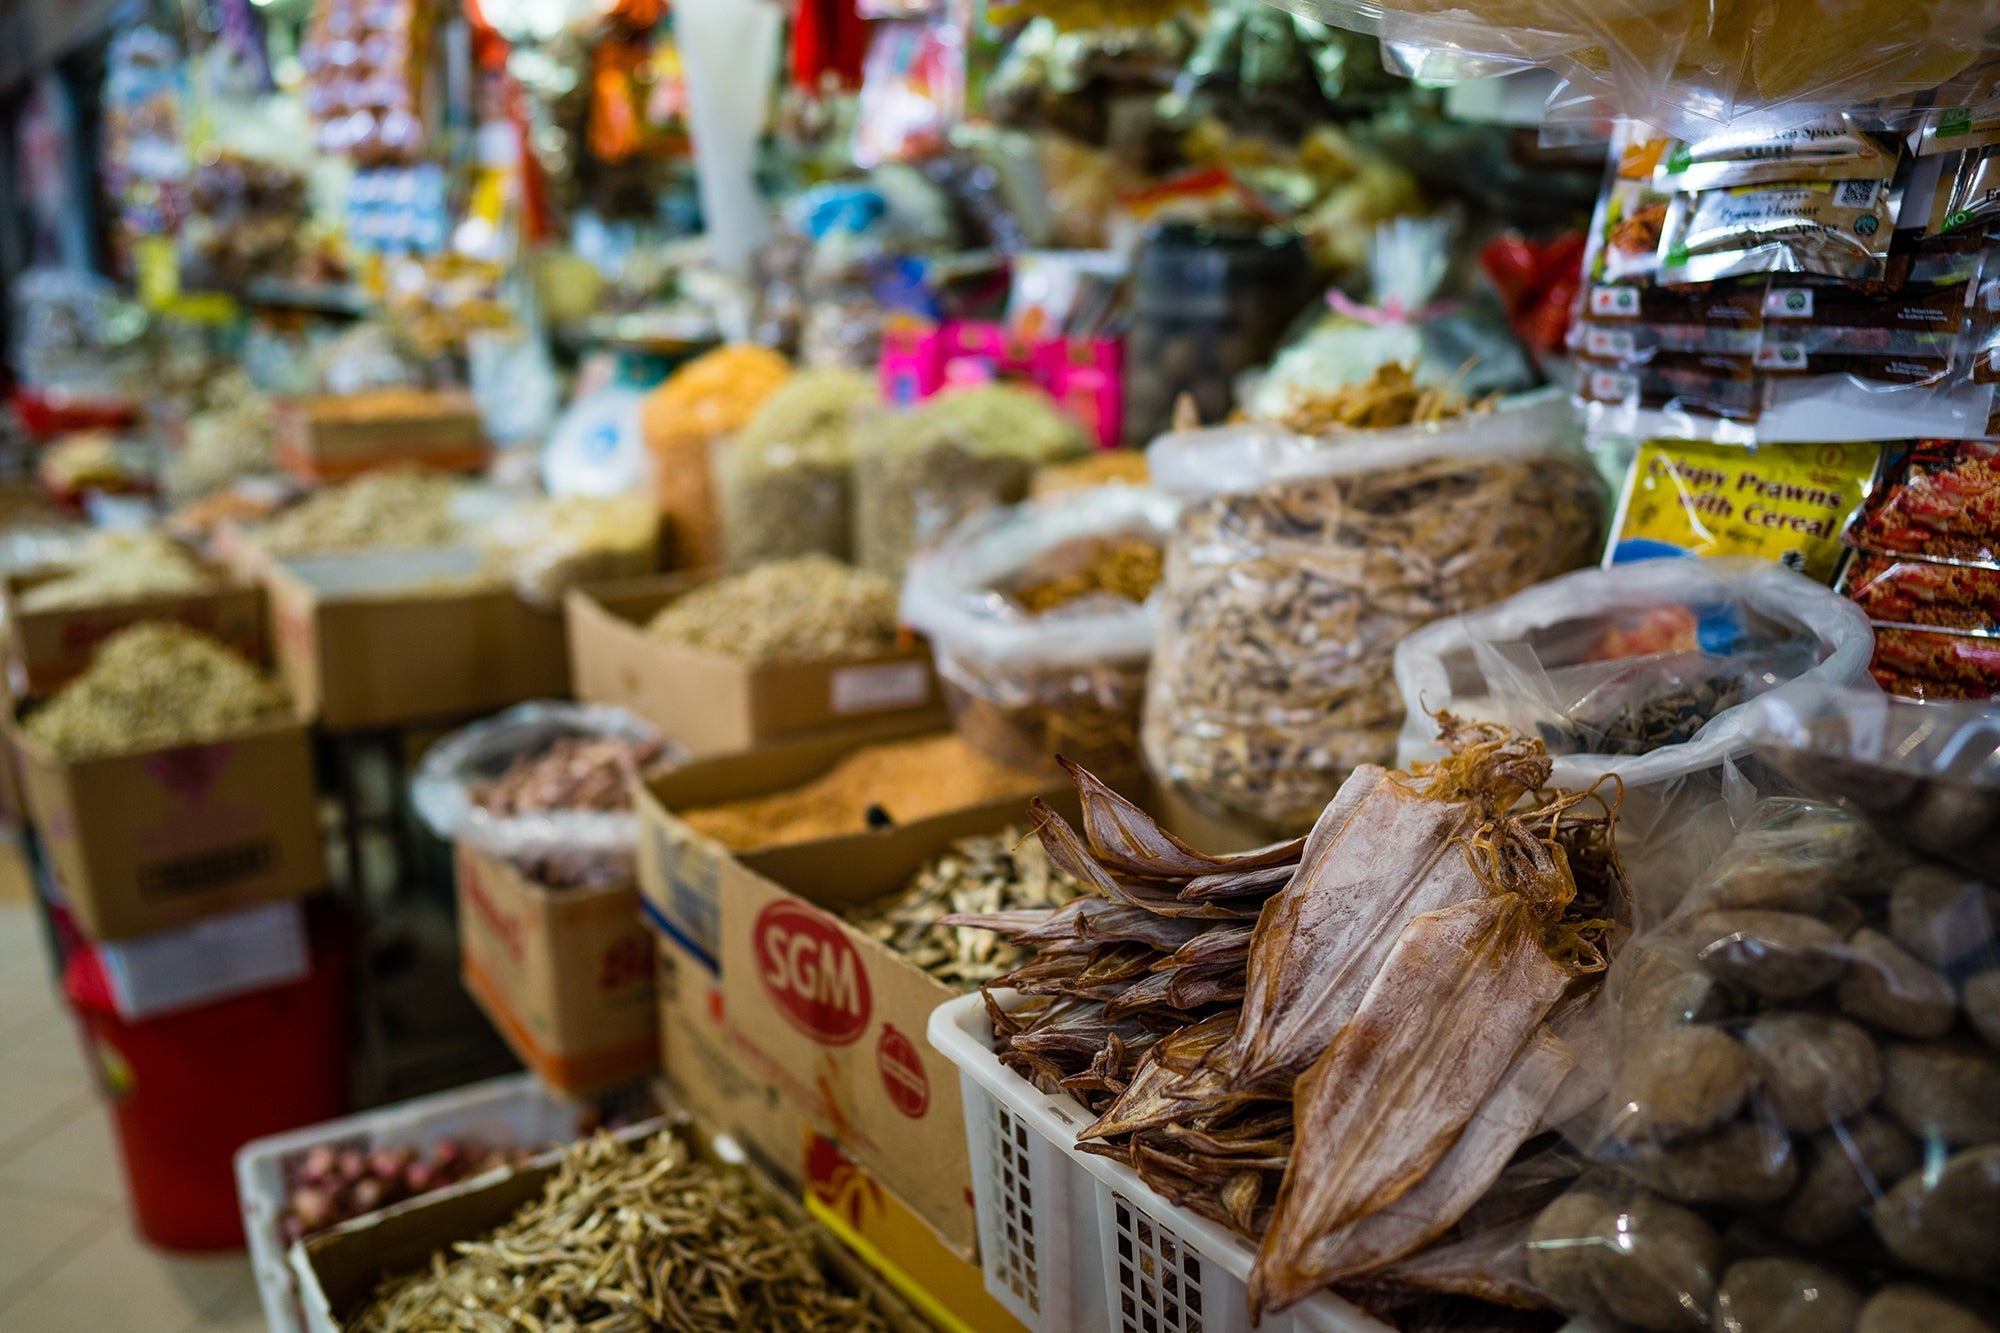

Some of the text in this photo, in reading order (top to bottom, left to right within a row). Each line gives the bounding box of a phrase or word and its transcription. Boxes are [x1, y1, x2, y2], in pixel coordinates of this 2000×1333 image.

[1766, 203, 1820, 217] Flavour
[1944, 213, 1967, 228] NO
[1736, 472, 1842, 509] Prawns
[1743, 503, 1837, 540] Cereal
[763, 925, 861, 1017] SGM
